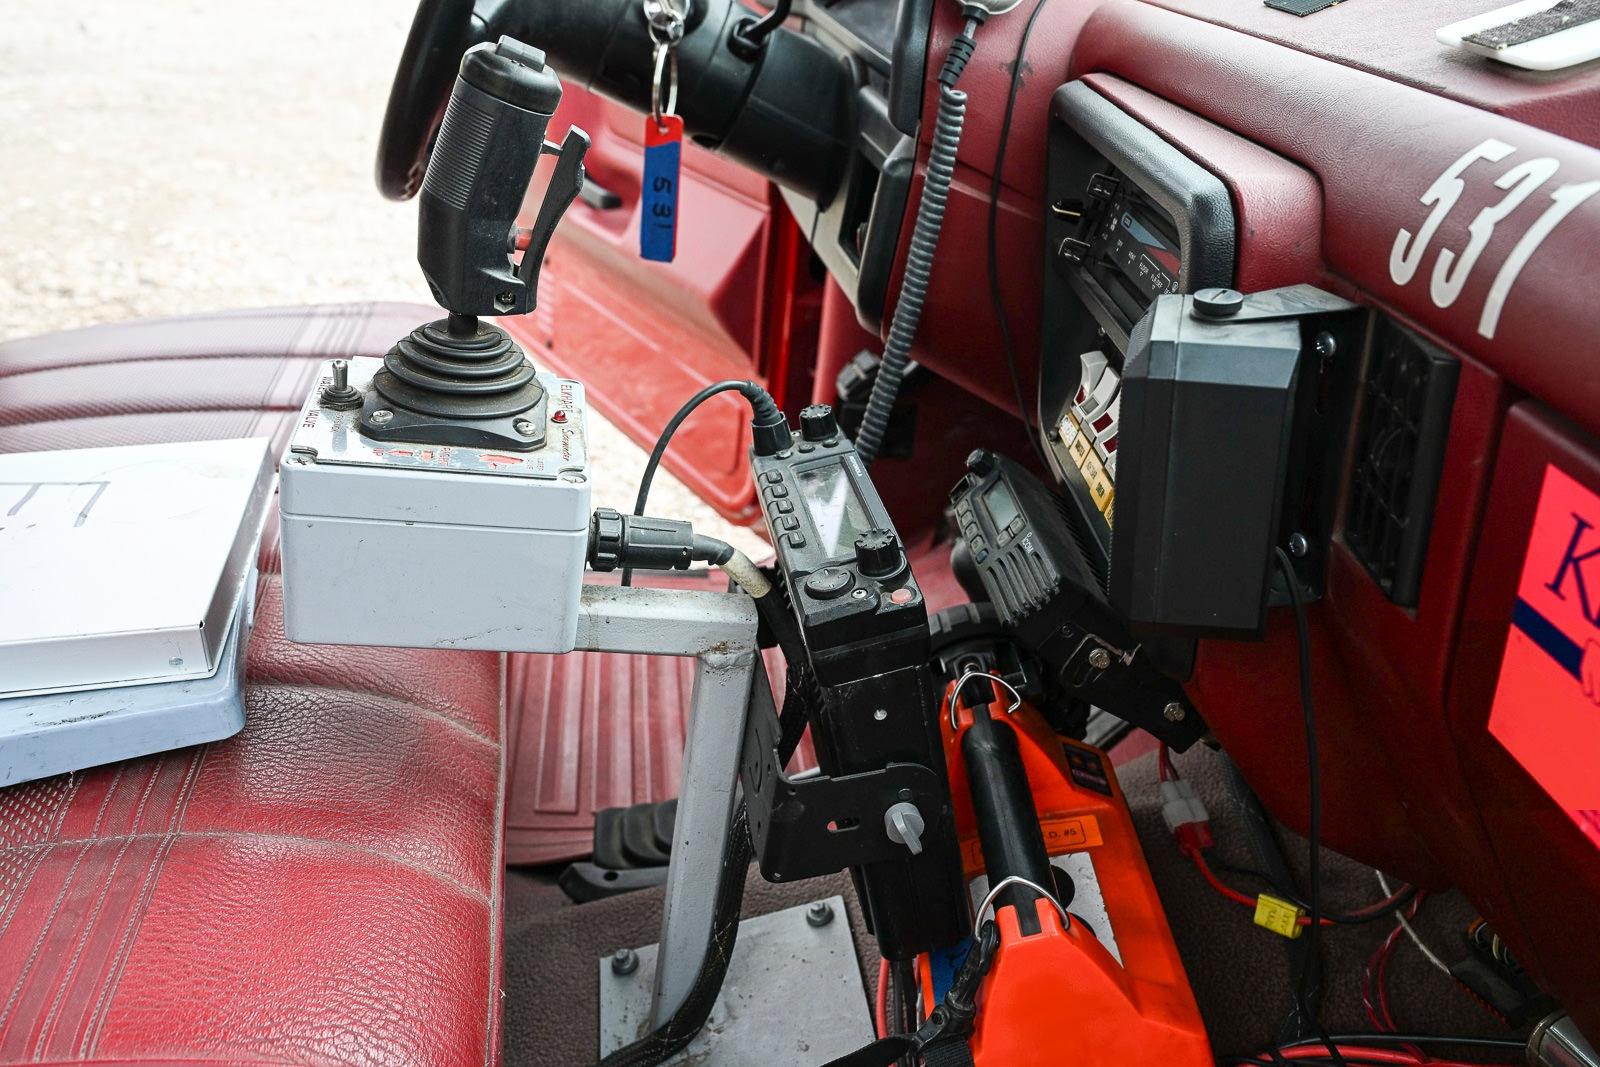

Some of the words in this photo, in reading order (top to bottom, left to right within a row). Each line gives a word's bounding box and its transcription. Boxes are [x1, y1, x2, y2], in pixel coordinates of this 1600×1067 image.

[652, 176, 673, 229] 531
[1389, 138, 1600, 340] 531
[302, 409, 321, 428] VALVE
[1543, 511, 1600, 630] K
